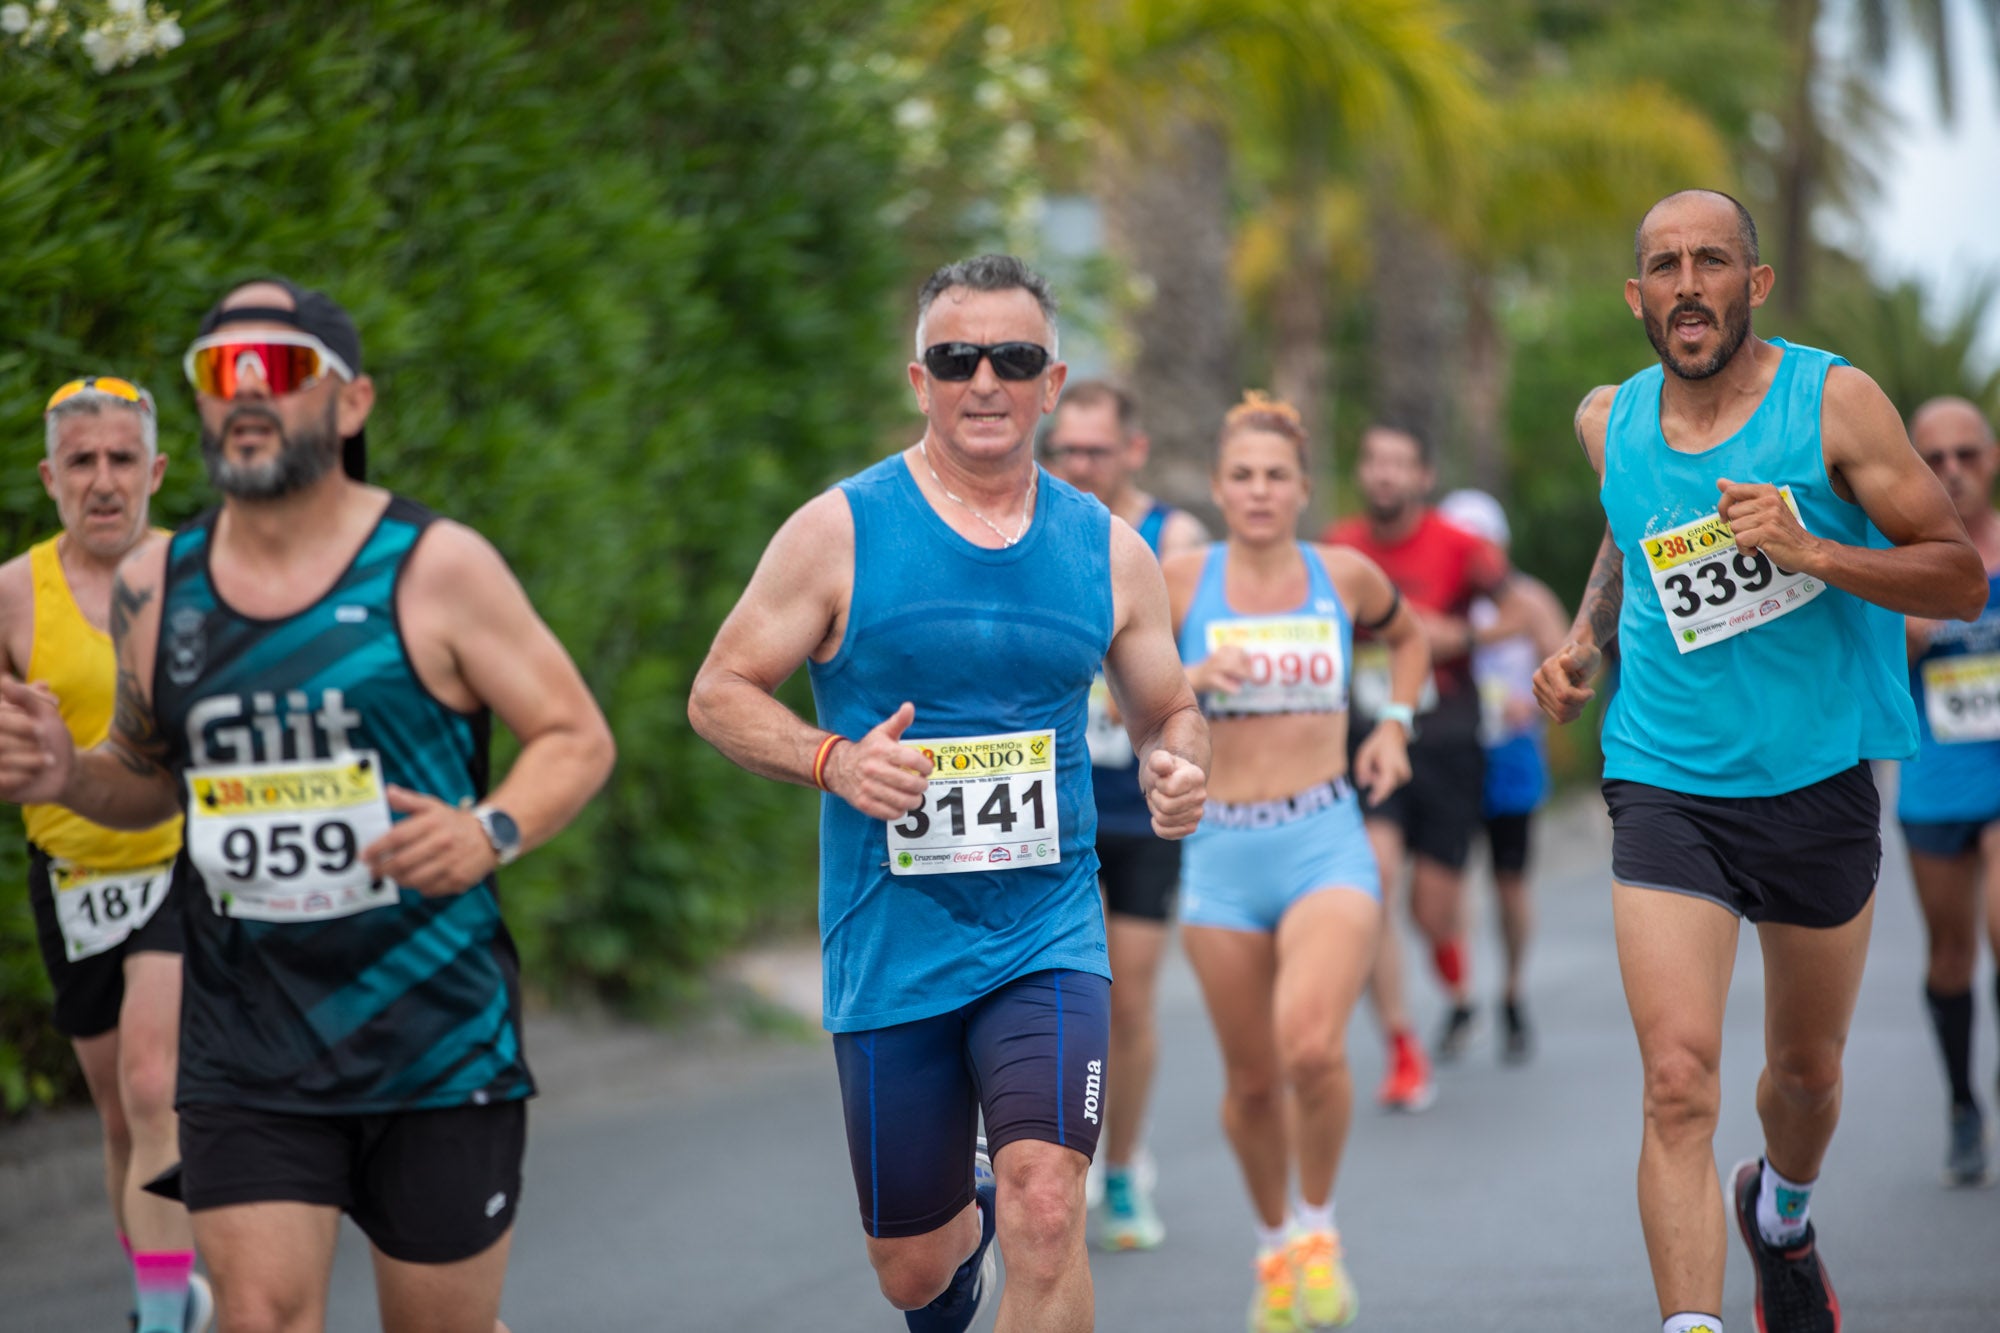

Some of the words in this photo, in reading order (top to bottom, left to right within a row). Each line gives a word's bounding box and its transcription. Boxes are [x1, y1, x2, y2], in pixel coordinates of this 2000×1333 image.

[1663, 536, 1687, 558] 38
[1686, 524, 1733, 552] FON
[1687, 523, 1714, 537] GRAN
[1664, 546, 1799, 618] 339
[1250, 652, 1335, 687] 090
[936, 749, 1024, 771] FONDO
[940, 745, 973, 755] GRAN
[975, 741, 1015, 753] PREMIO
[894, 780, 1045, 839] 3141
[222, 820, 358, 881] 959
[914, 853, 950, 862] Cruzcampo
